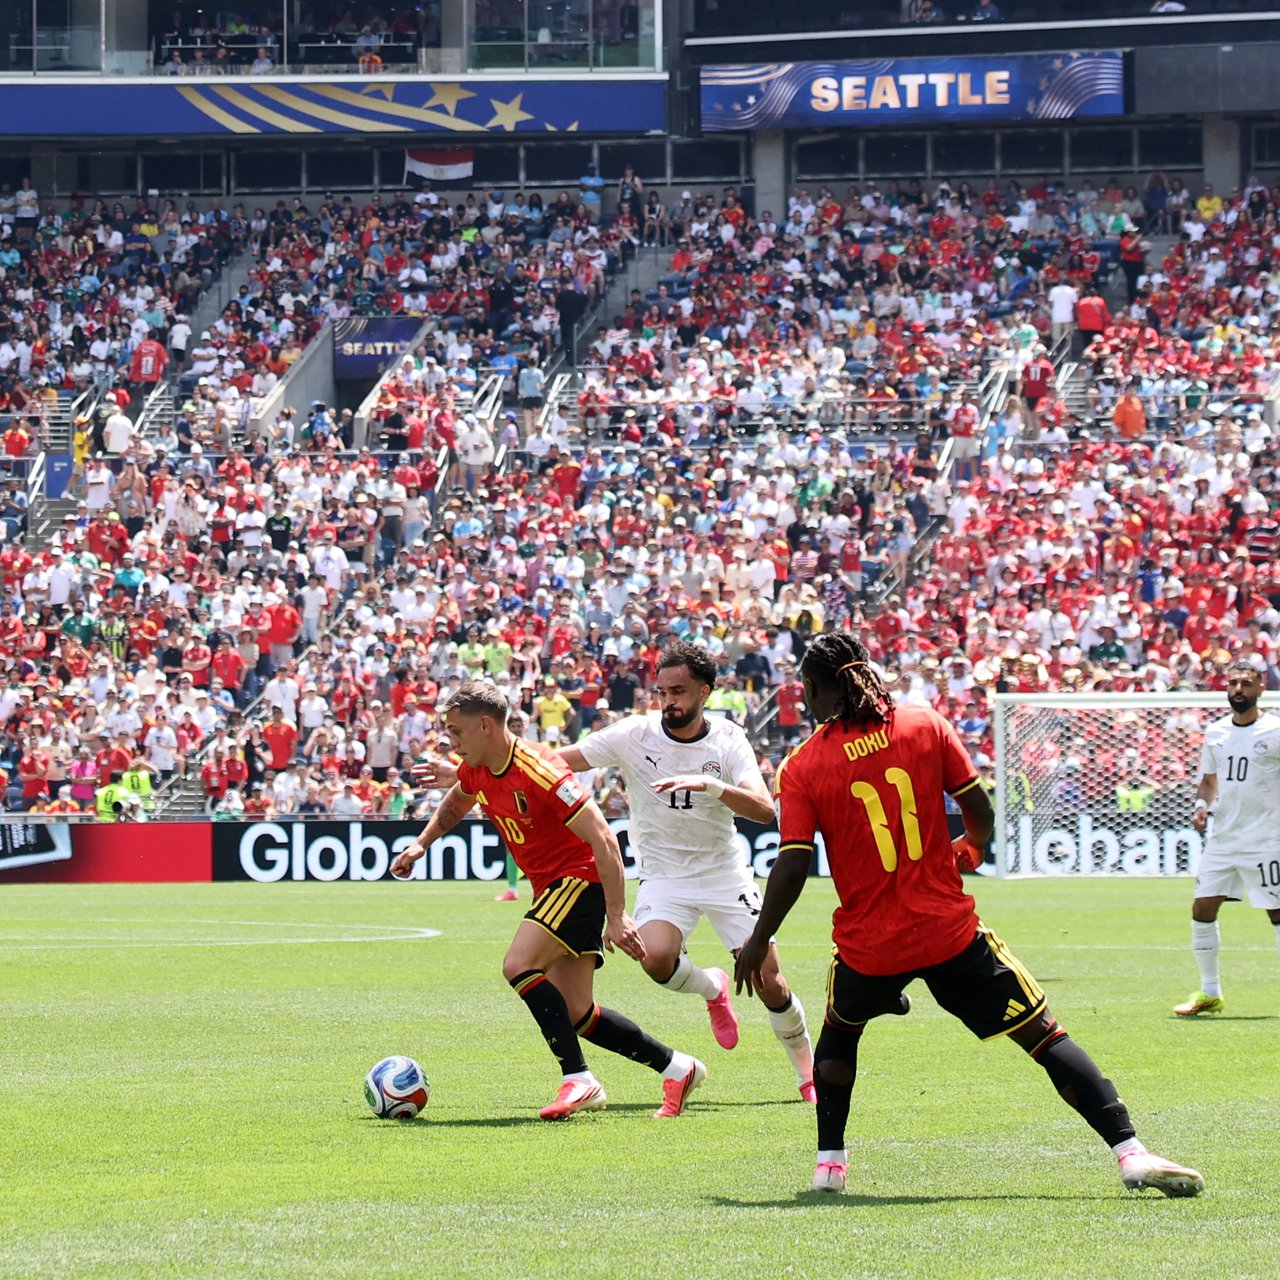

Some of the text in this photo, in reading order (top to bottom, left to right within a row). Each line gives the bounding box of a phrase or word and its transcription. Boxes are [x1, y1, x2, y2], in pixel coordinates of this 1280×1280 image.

[811, 70, 1010, 112] SEATTLE
[843, 729, 890, 762] DOKU
[1226, 755, 1249, 782] 10
[494, 814, 526, 845] 10
[850, 767, 923, 873] 11
[239, 822, 504, 883] Globant
